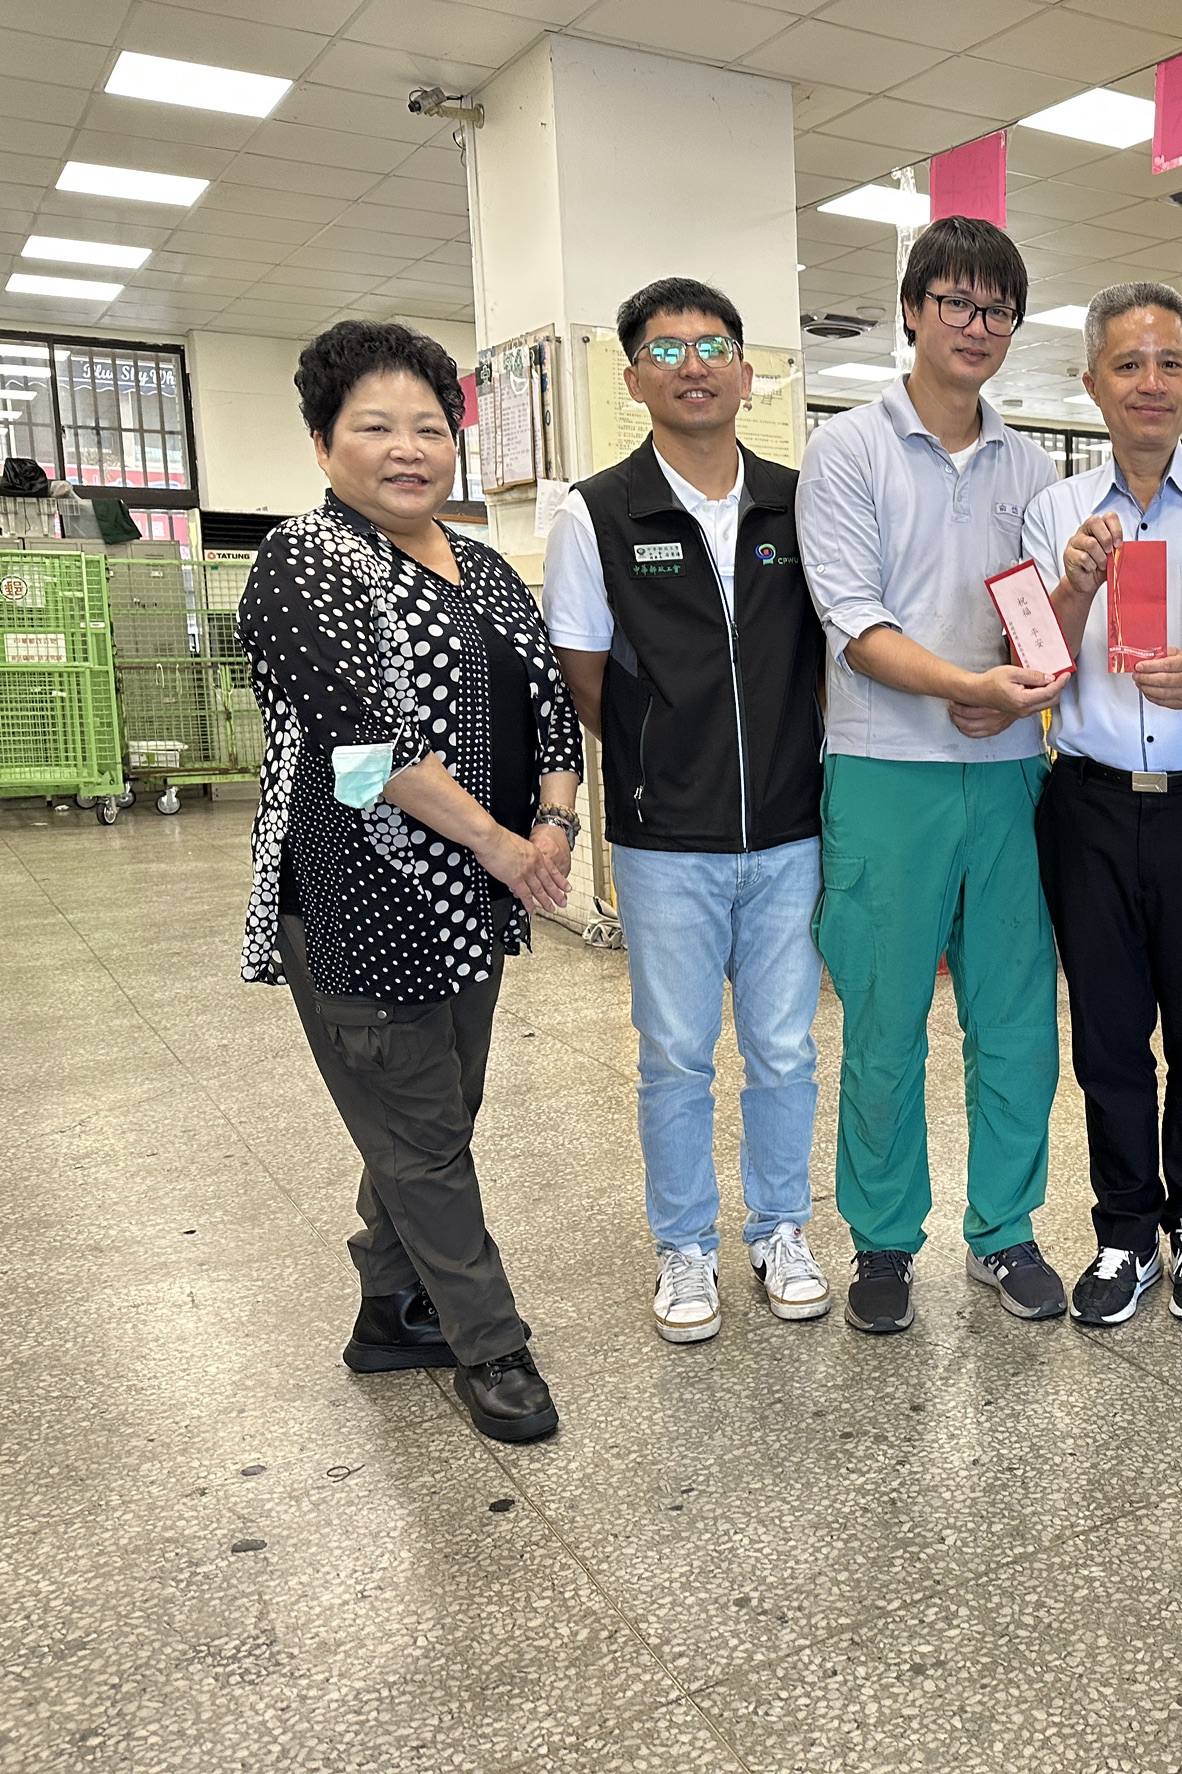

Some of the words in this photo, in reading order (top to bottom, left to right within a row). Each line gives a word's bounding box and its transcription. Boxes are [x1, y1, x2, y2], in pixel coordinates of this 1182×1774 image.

[83, 363, 116, 379] Blu
[216, 552, 250, 560] TATUNG
[1030, 627, 1044, 649] 平安
